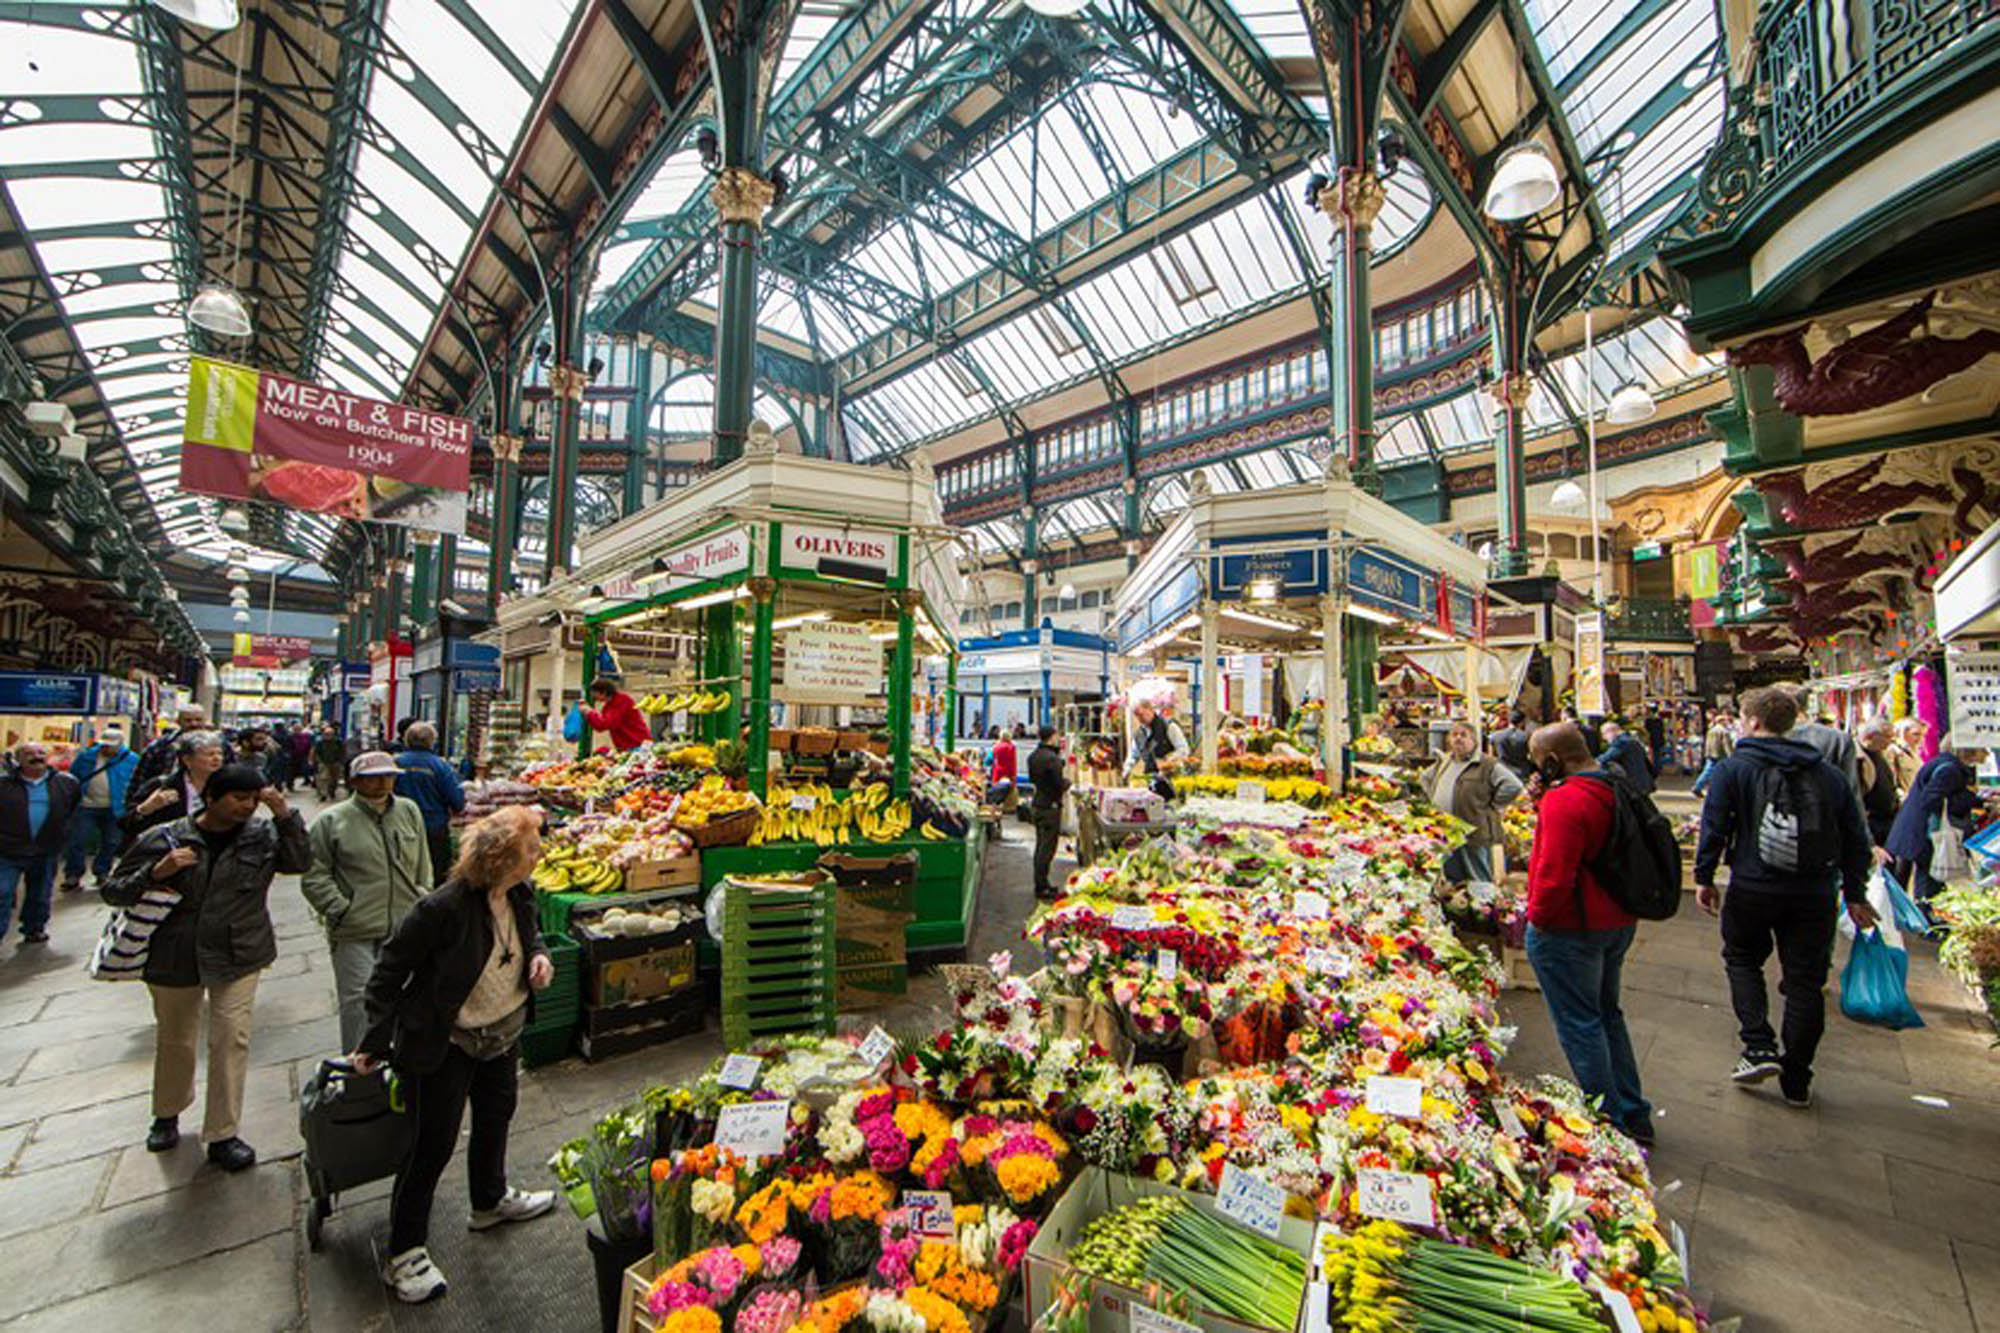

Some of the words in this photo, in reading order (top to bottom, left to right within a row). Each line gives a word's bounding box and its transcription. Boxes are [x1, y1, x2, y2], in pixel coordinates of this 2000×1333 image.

[266, 379, 359, 416] MEAT
[370, 403, 390, 425] &
[403, 410, 468, 441] FISH
[264, 401, 309, 421] Now
[315, 414, 340, 429] on
[347, 418, 425, 447] Butchers
[430, 435, 468, 455] Row
[348, 445, 394, 464] 1904
[704, 539, 740, 567] Fruits
[795, 536, 886, 559] OLIVERS
